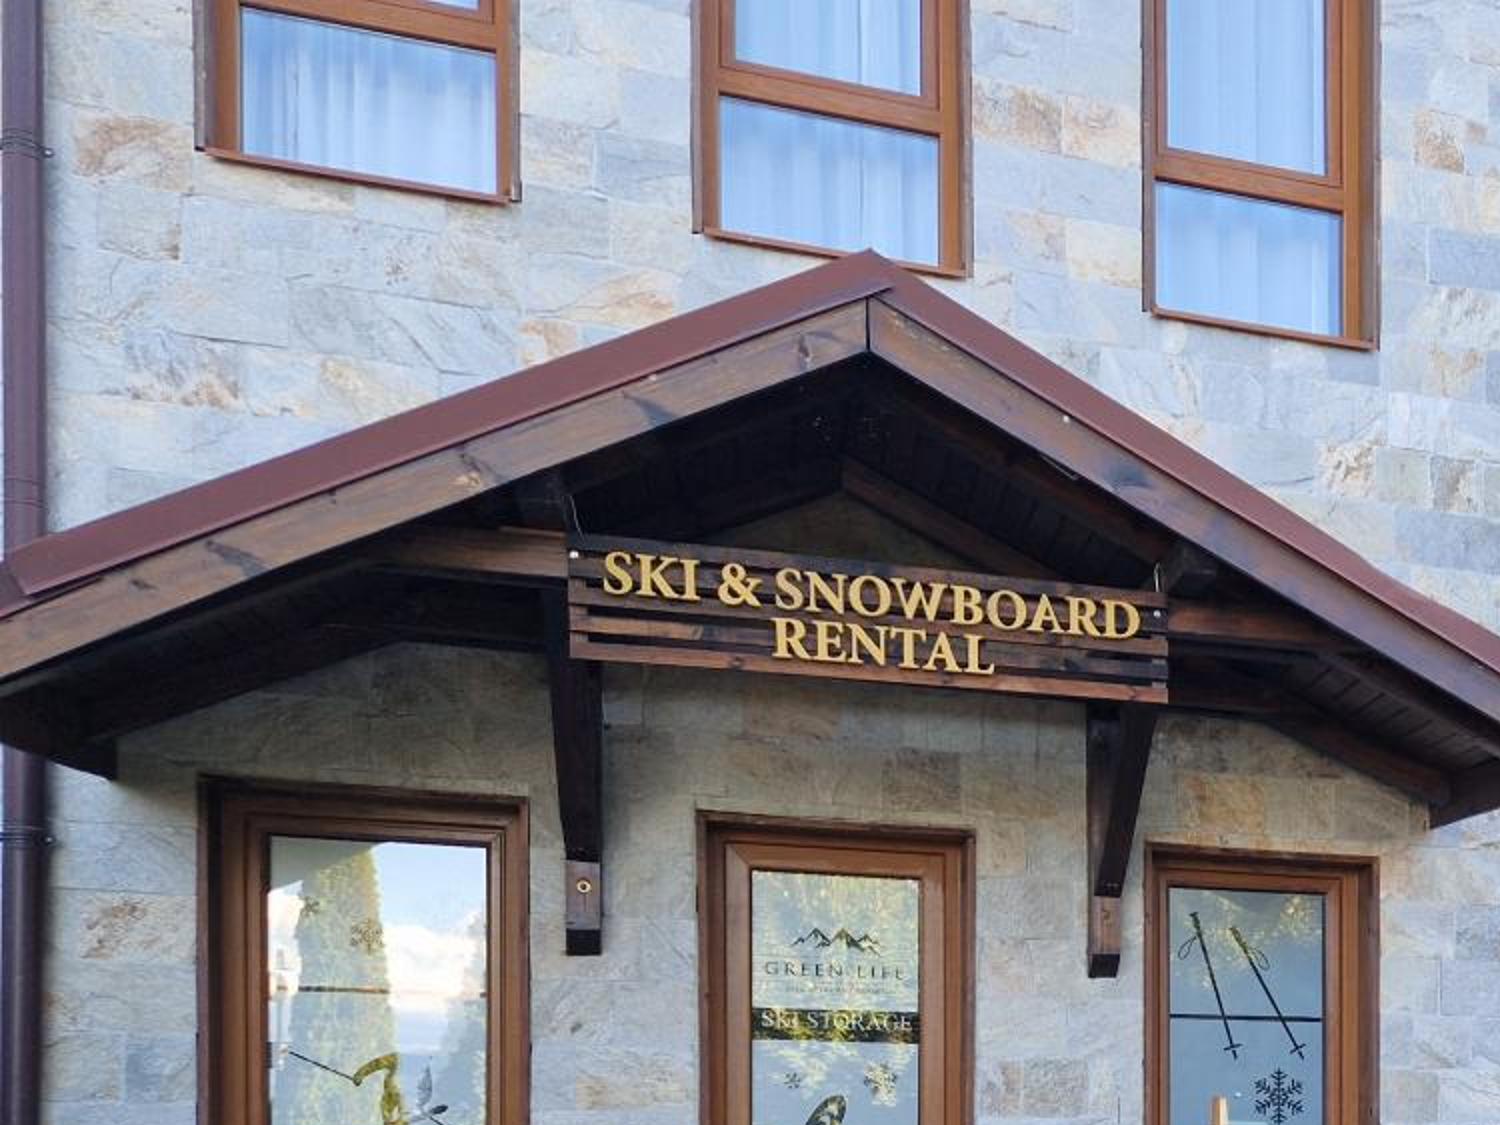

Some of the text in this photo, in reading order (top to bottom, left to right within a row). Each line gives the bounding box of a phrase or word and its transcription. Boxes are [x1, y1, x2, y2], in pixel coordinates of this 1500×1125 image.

[603, 551, 1141, 640] SKI & SNOWBOARD
[771, 617, 995, 675] RENTAL
[765, 960, 905, 981] GREEN LIFE
[761, 1009, 913, 1032] SKI STORAGE
